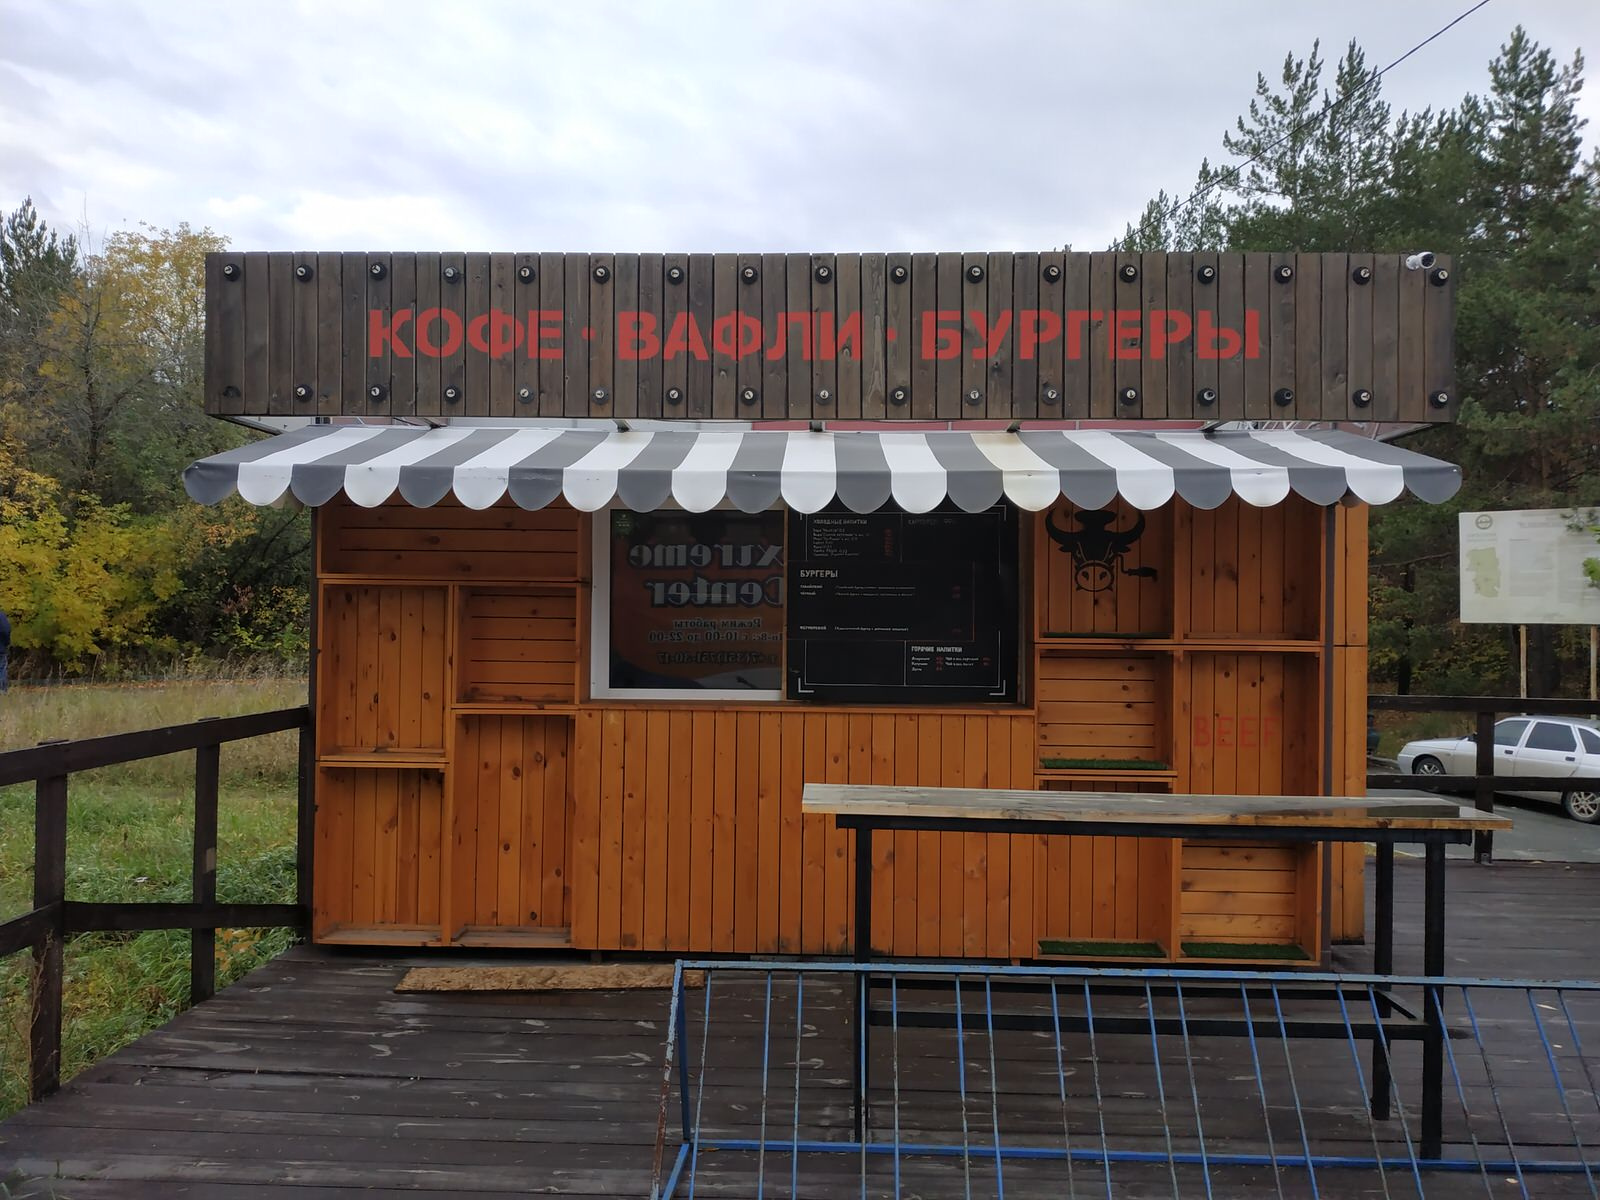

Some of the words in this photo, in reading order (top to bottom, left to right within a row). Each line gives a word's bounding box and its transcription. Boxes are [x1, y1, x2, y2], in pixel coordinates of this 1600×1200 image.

[367, 307, 564, 359] КОФЕ
[617, 310, 864, 361] ВАФЛИ
[921, 309, 1261, 361] БУРГЕРЫ
[800, 569, 839, 578] БУРГЕРЫ
[1194, 717, 1280, 747] BEEF
